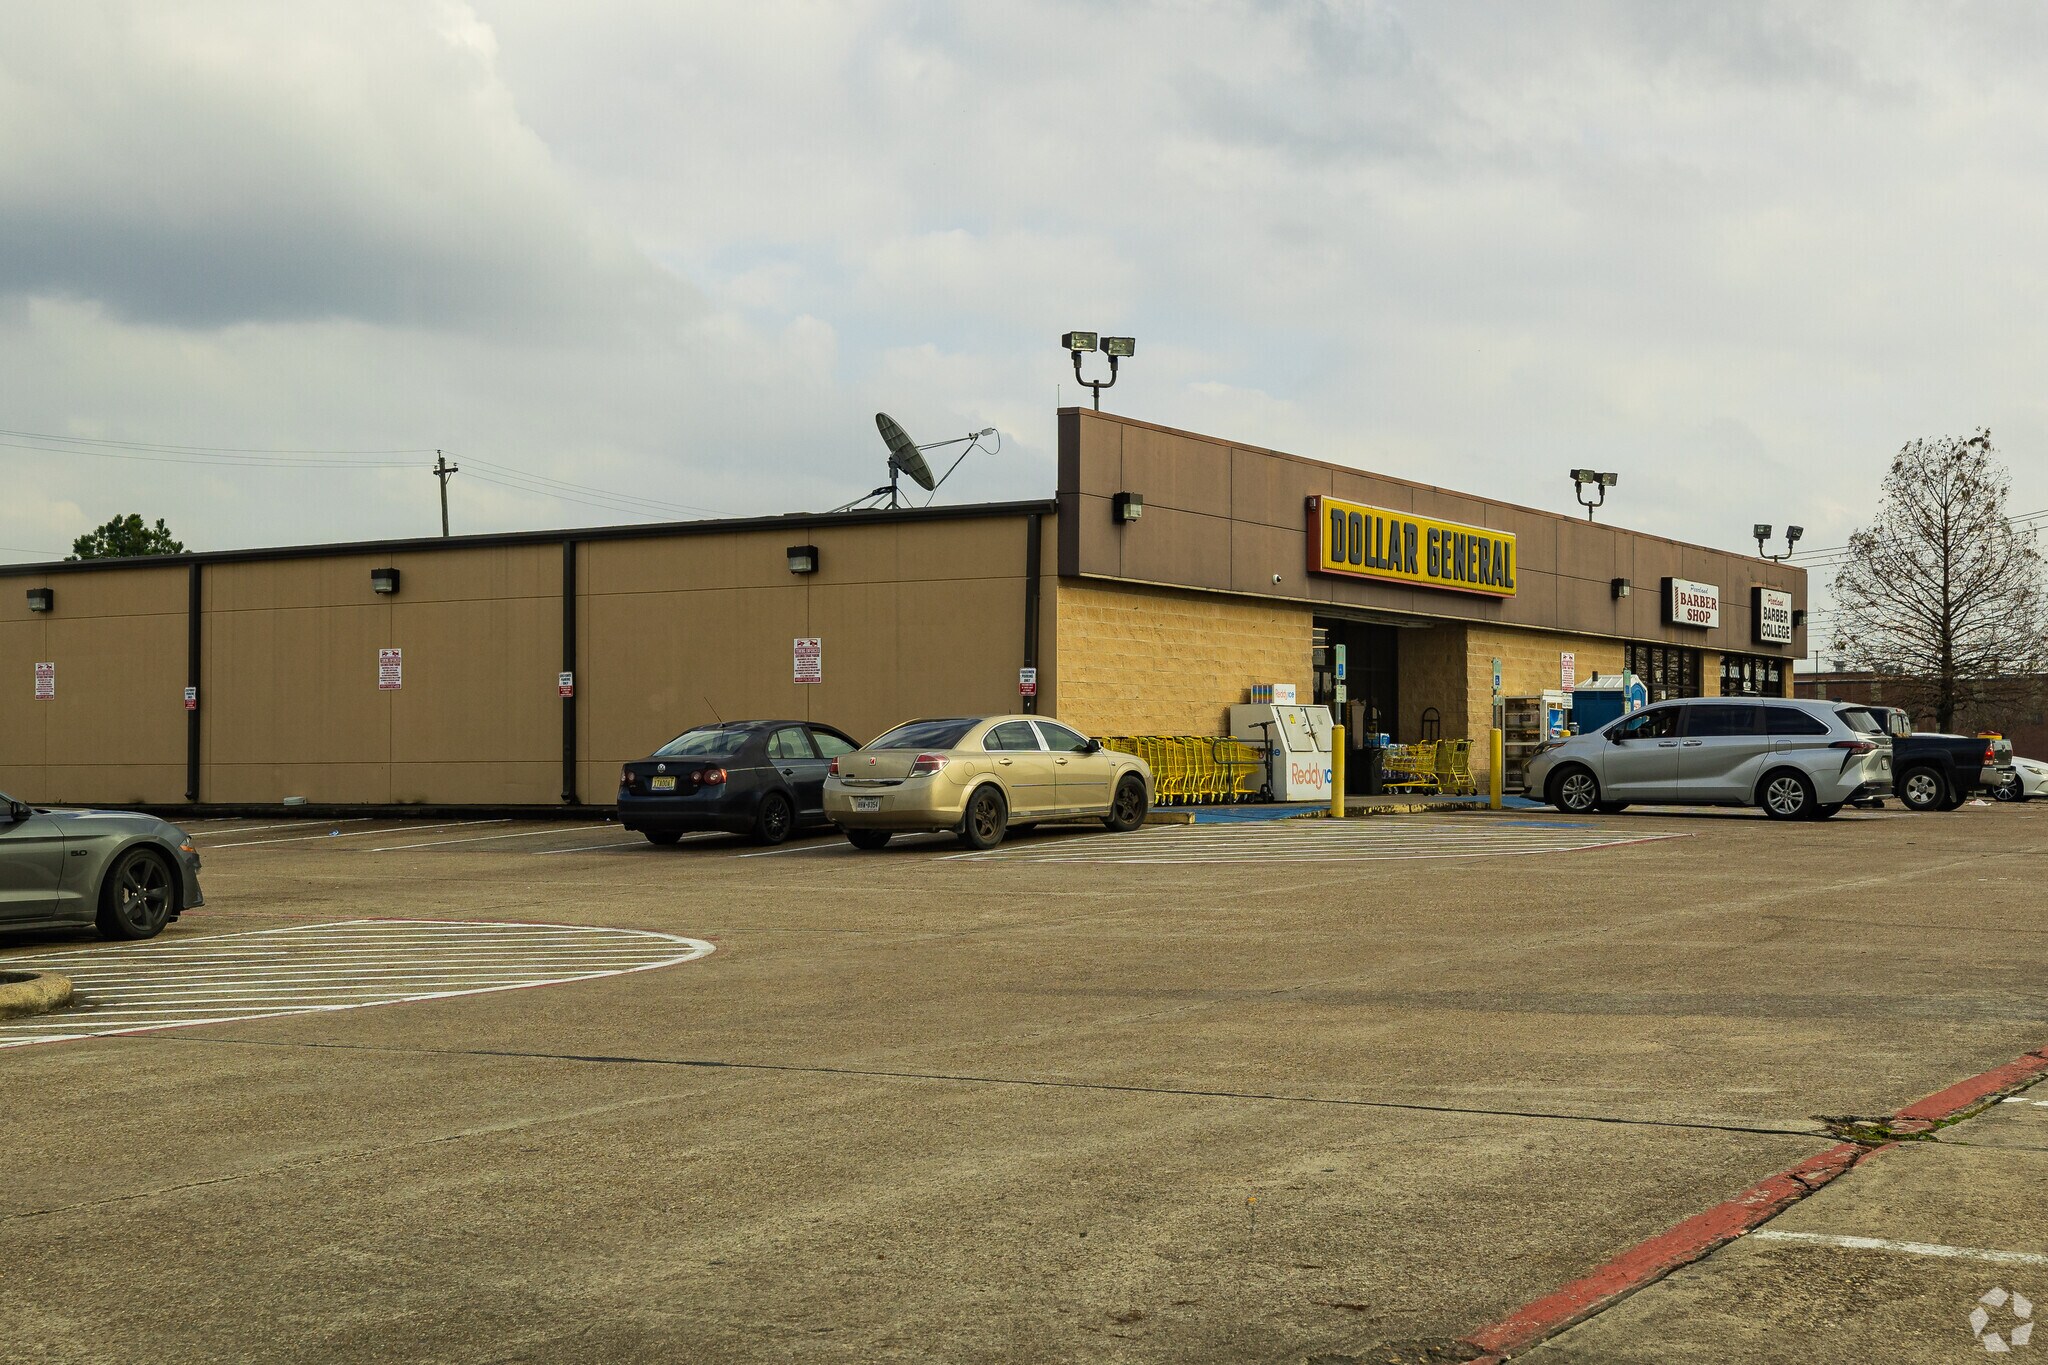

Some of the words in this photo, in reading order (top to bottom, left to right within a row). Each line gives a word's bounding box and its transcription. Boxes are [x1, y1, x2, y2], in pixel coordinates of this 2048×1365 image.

[1331, 508, 1418, 573] DOLLAR
[1427, 527, 1514, 588] GENERAL
[1680, 592, 1717, 610] BARBER
[1687, 608, 1710, 623] SHOP
[1763, 606, 1788, 623] BARBER
[1762, 622, 1790, 639] COLLEGE
